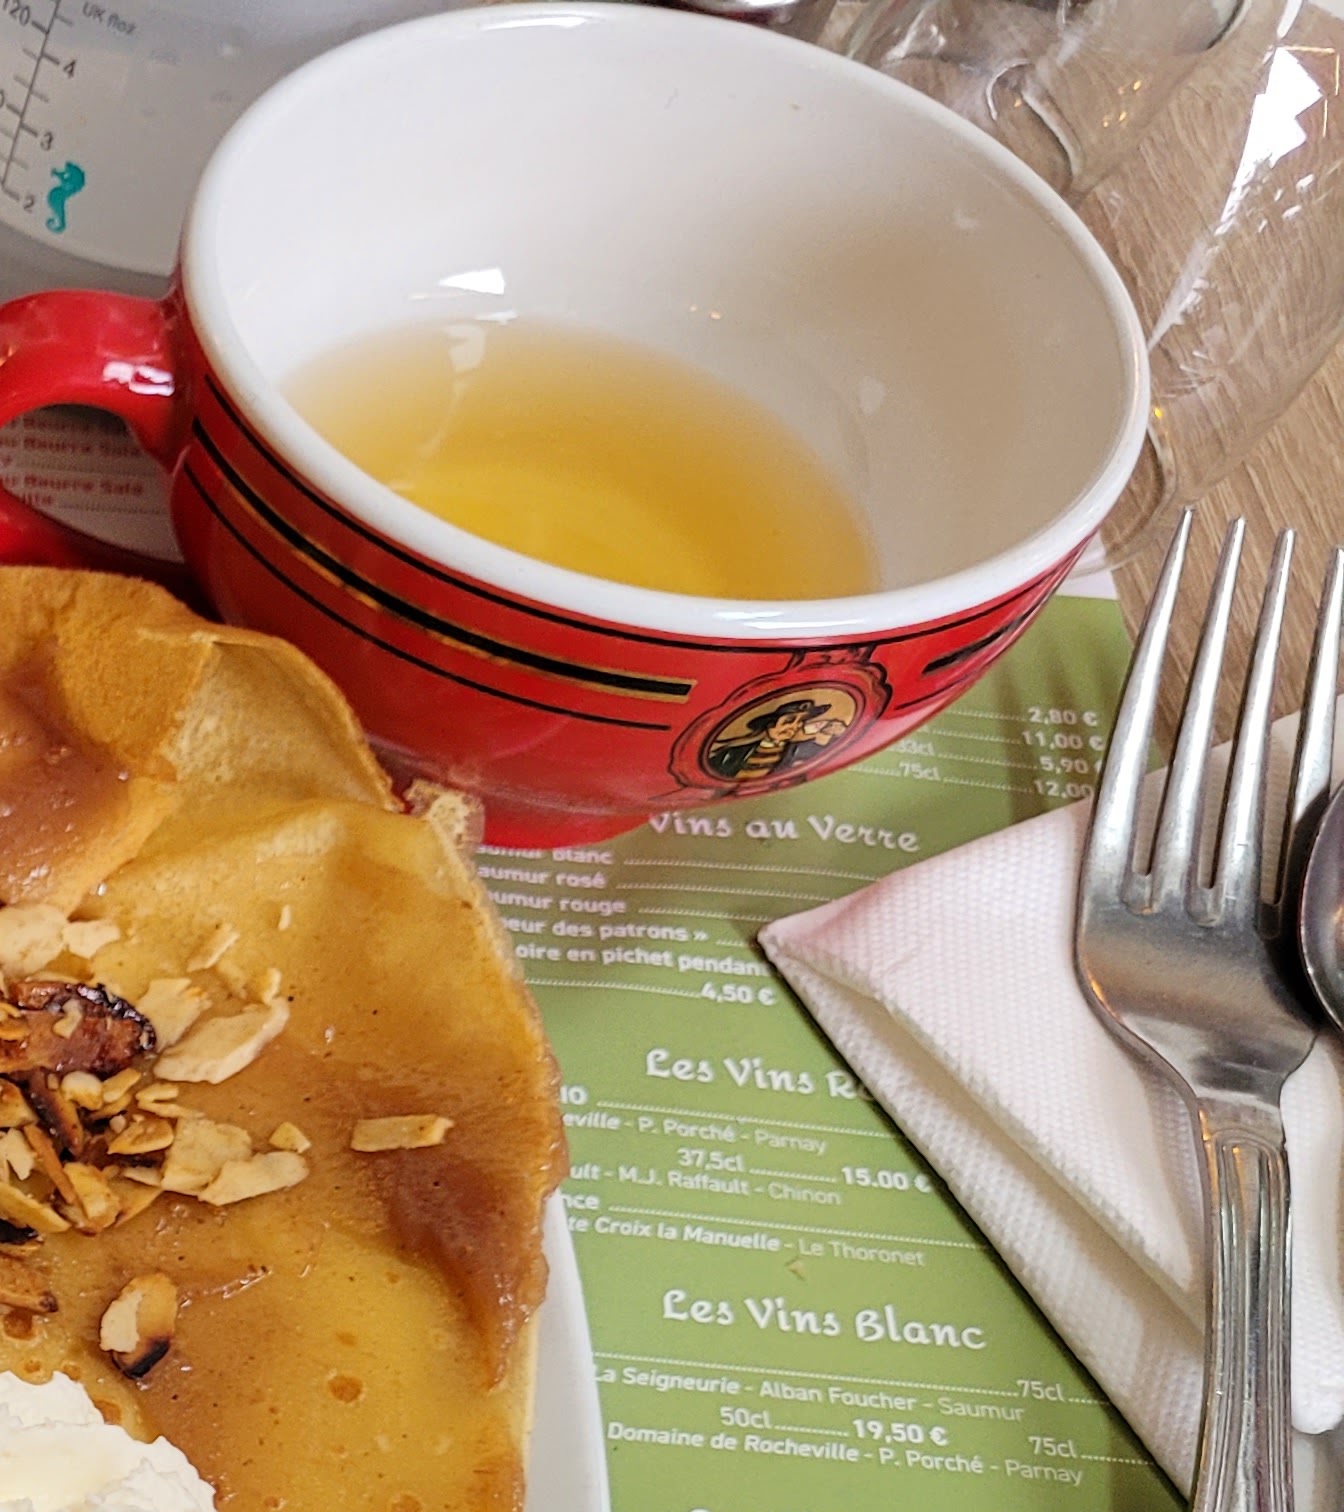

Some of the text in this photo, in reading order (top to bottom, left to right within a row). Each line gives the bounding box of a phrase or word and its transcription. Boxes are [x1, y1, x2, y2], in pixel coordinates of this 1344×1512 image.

[63, 59, 77, 78] 4
[40, 131, 54, 151] 3
[23, 194, 36, 214] 2
[648, 810, 921, 853] Vins au Verre
[555, 869, 607, 890] rosé
[559, 896, 627, 918] rouge
[553, 918, 688, 944] des patrons
[602, 944, 674, 969] pichet
[700, 980, 753, 1004] 4,50
[645, 1048, 714, 1084] Les
[723, 1055, 814, 1096] Vins
[664, 1118, 828, 1155] Porché Parnay
[668, 1171, 843, 1206] Raffault Chinon
[841, 1165, 910, 1191] 15.00
[594, 1217, 926, 1266] Croix Manuelle Thoronet
[662, 1289, 987, 1350] Les Vins Blanc
[622, 1366, 1025, 1422] Seigneurie Alban Foucher Saumur
[1016, 1379, 1065, 1402] 75cl
[719, 1406, 1077, 1459] 50cl 19,50 75cl
[607, 1421, 1083, 1487] Domaine Rocheville Porché Parnay
